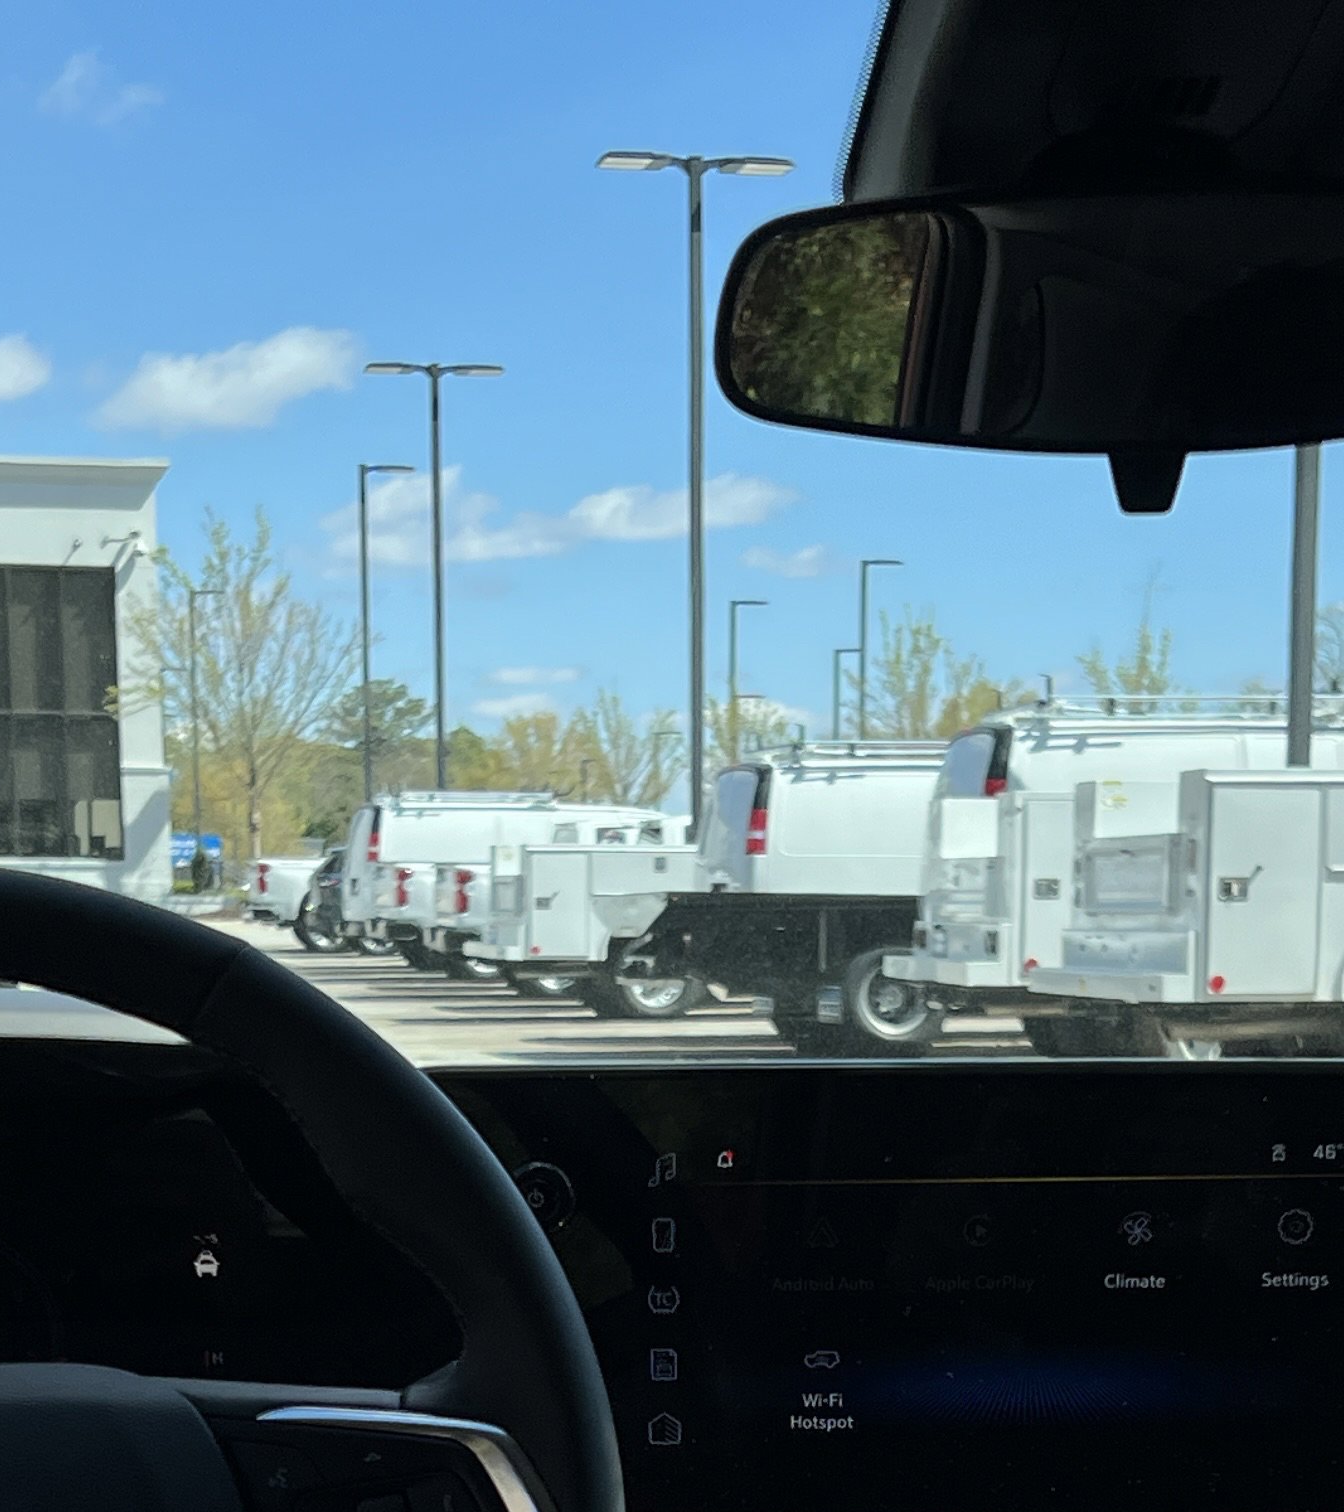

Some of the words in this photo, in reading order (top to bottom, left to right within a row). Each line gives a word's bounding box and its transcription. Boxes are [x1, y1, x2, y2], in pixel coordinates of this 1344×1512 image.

[772, 1275, 836, 1292] Android
[840, 1275, 875, 1292] Auto
[924, 1275, 971, 1294] Apple
[974, 1275, 1034, 1294] CarPlay
[1104, 1273, 1167, 1290] Climate
[1261, 1271, 1330, 1291] Settings
[801, 1391, 844, 1409] Wi-Fi
[789, 1414, 855, 1433] Hotspot
